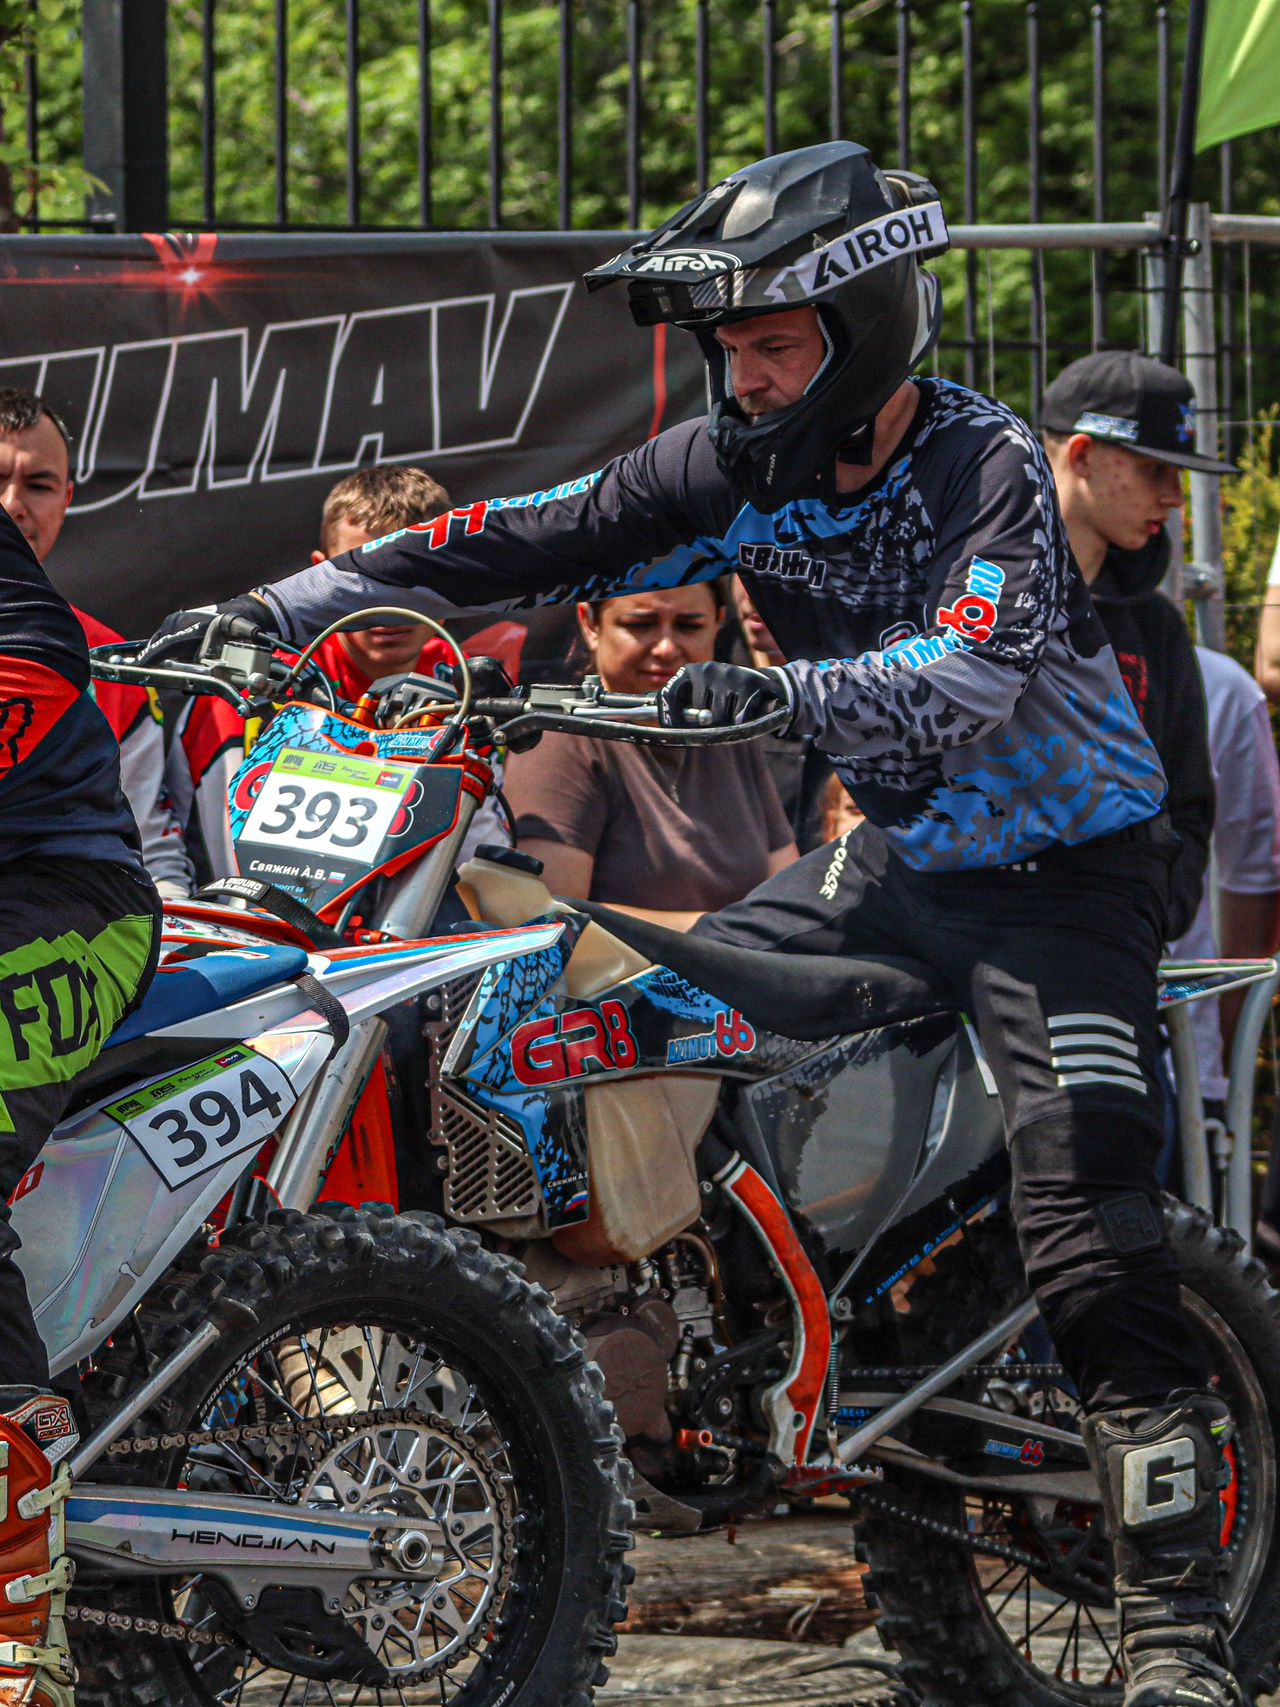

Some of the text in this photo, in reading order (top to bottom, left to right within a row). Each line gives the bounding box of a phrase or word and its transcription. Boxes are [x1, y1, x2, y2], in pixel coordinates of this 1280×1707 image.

[636, 253, 728, 273] Airoh
[812, 210, 935, 291] AIROH
[259, 784, 378, 847] 393
[226, 877, 264, 892] ENDURO
[249, 859, 300, 876] Свяжин
[510, 999, 640, 1086] GR8
[148, 1068, 282, 1168] 394
[200, 1368, 237, 1419] ENDURO
[247, 1323, 292, 1361] SERIES
[1123, 1436, 1196, 1527] G
[171, 1527, 337, 1555] HENGJIAN
